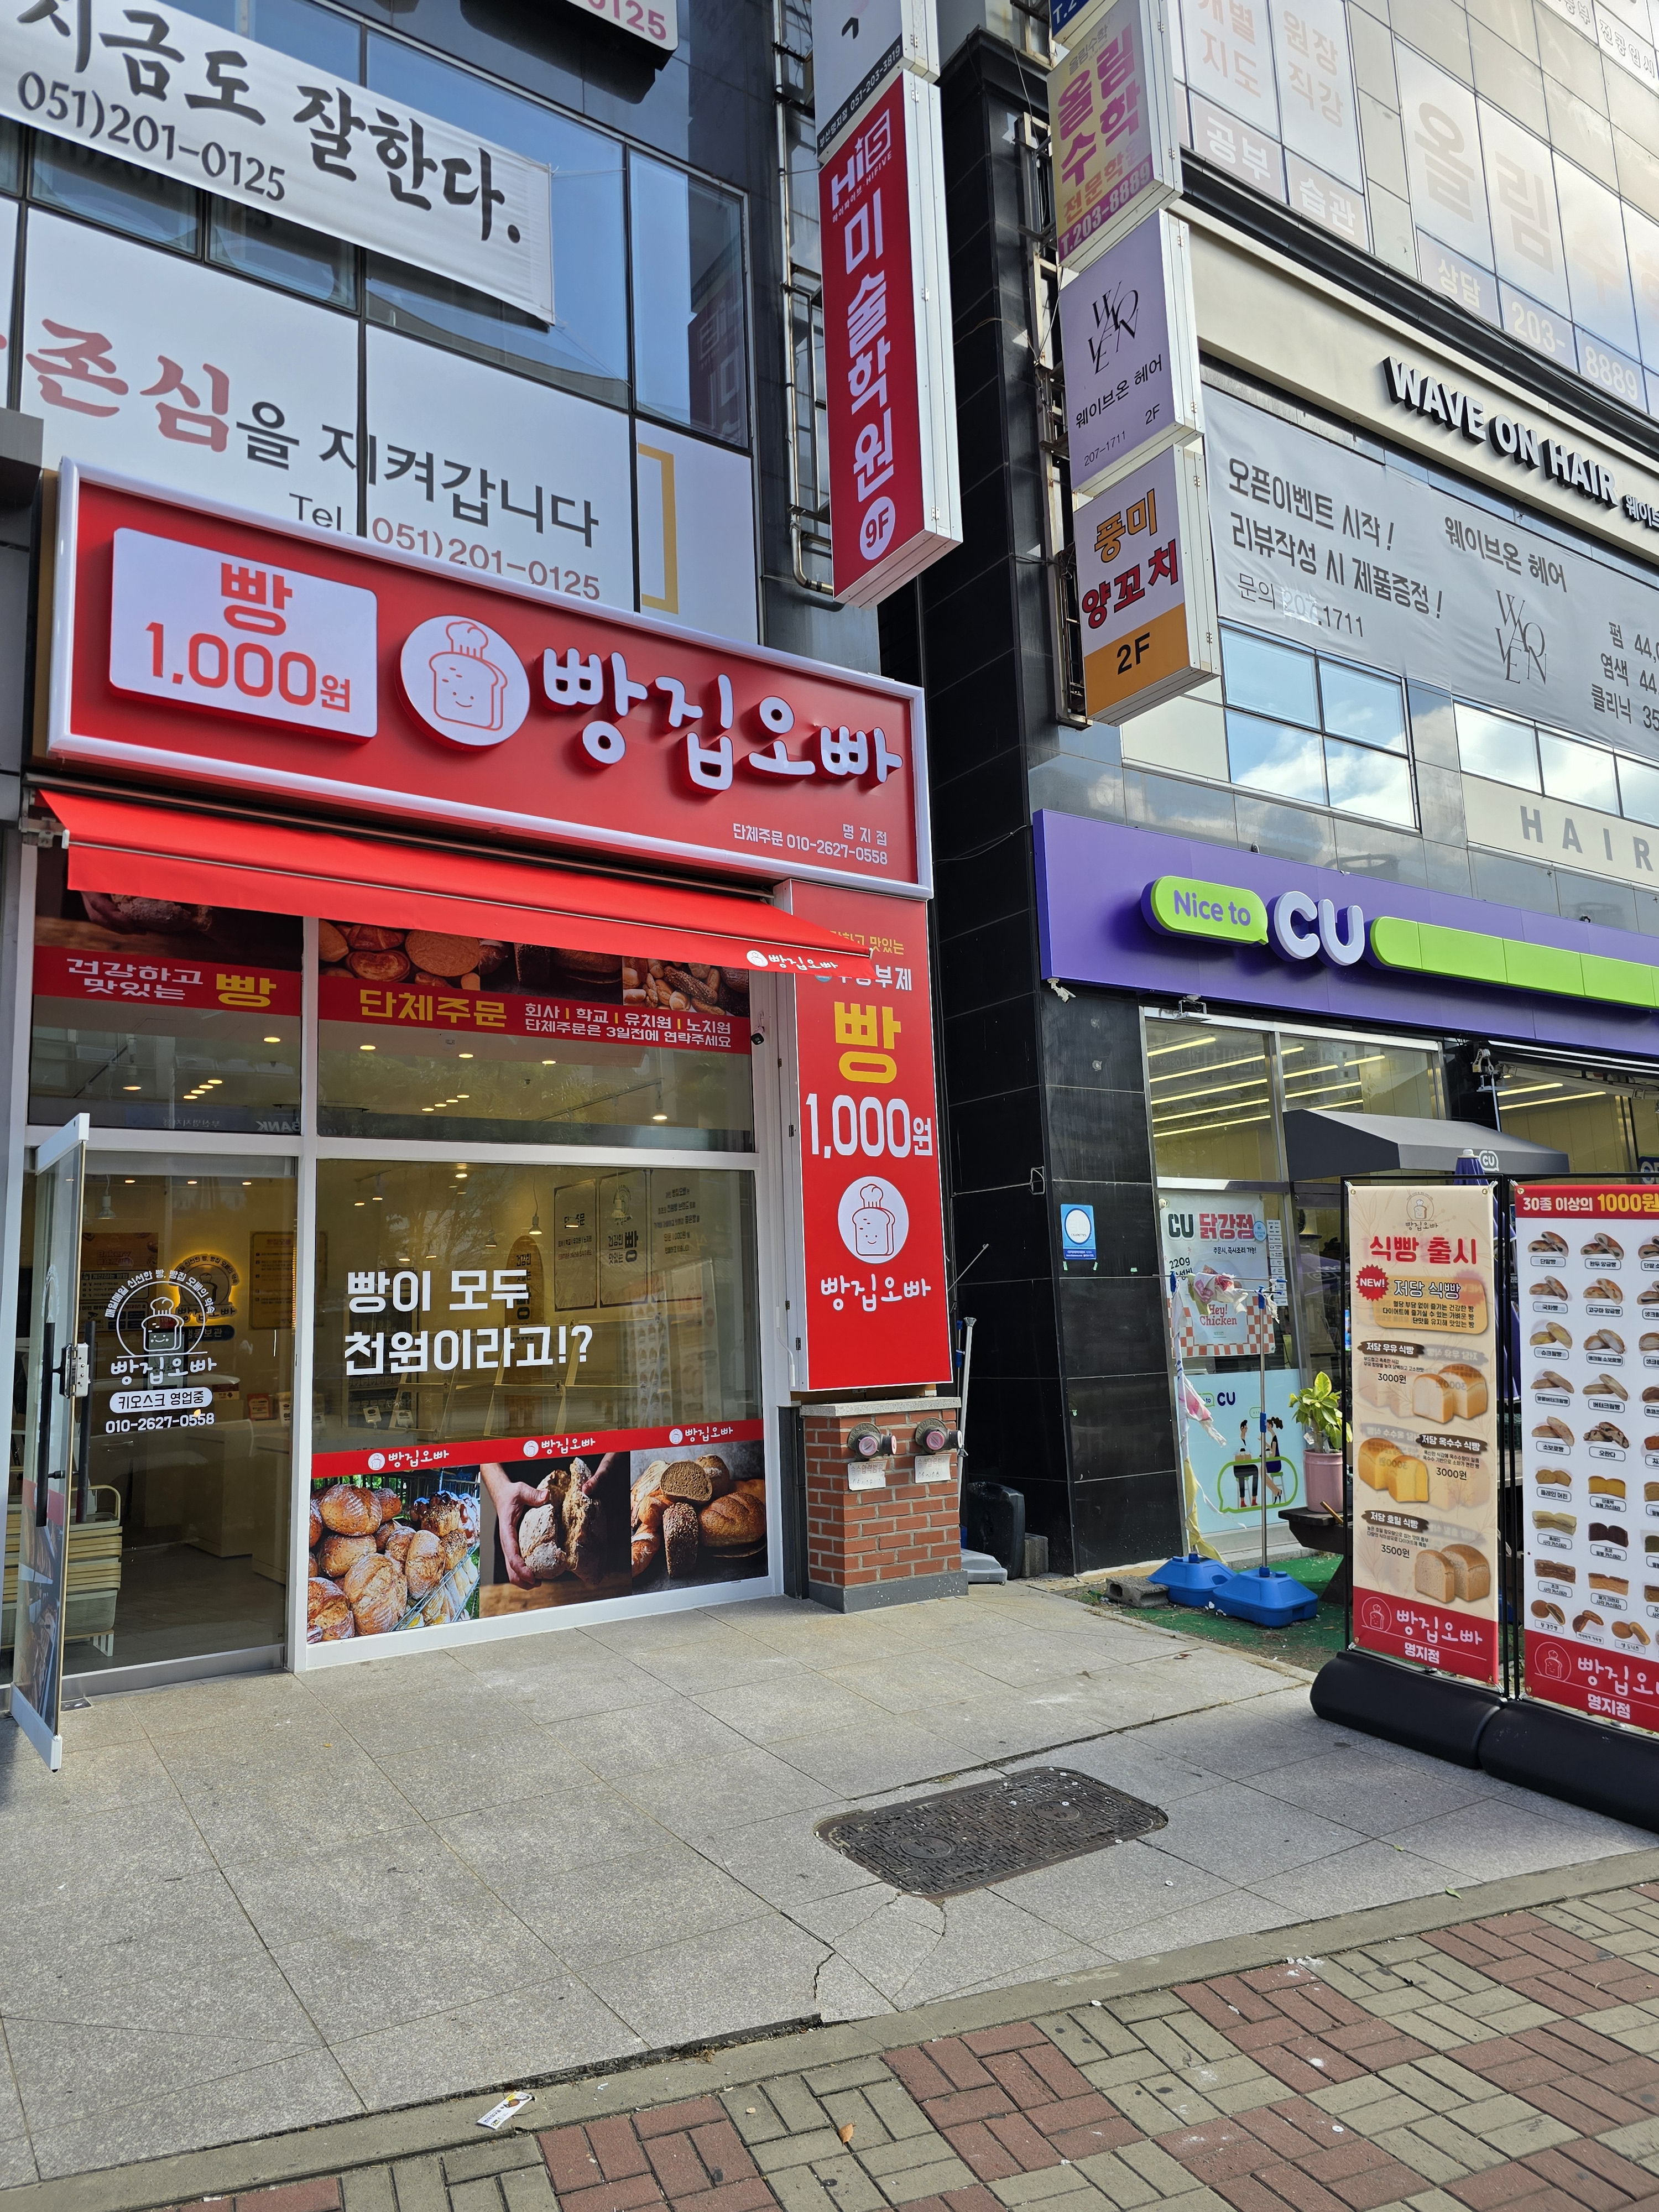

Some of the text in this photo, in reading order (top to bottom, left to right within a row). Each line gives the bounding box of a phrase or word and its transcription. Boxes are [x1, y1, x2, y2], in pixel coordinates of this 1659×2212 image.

[819, 44, 901, 149] 부산명지점 051-203-3819
[17, 0, 521, 244] 지금도 잘한다.
[17, 71, 286, 201] 051)201-0125
[1207, 116, 1271, 181] 공부
[1437, 258, 1481, 309] 상담
[844, 187, 894, 503] 미술학원
[1075, 353, 1162, 429] 웨이브온 헤어
[1145, 403, 1160, 425] 2F
[1083, 430, 1126, 467] 207-1711
[1384, 356, 1619, 508] WAVE ON HAIR
[319, 424, 599, 549] 지켜갑니다
[865, 505, 889, 549] 9F
[1093, 487, 1158, 564] 풍미
[1228, 457, 1334, 531] 오픈이벤트
[1444, 516, 1522, 576] 웨이브온
[1528, 553, 1567, 593] 헤어
[372, 517, 601, 601] 051)201-0125
[1230, 511, 1317, 575] 리뷰작성
[1326, 549, 1345, 586] 시
[221, 562, 293, 637] 빵
[1081, 538, 1179, 629] 양꼬치
[1237, 572, 1276, 610] 문의
[1608, 621, 1625, 650] 펌
[145, 621, 351, 713] 1.000원
[1117, 632, 1151, 676] 2F
[1600, 653, 1629, 687] 염색
[539, 647, 903, 792] 빵집오빠
[1590, 683, 1632, 725] 클리닉
[733, 823, 888, 865] 단체주문 010-2627-0558
[1520, 805, 1654, 872] HAIR
[1173, 889, 1251, 927] Nice to
[1272, 890, 1366, 967] CU
[768, 954, 838, 971] 빵집오빠
[869, 936, 904, 956] 맛있는
[66, 958, 204, 985] 건강하고
[84, 977, 186, 1000] 맛있는
[216, 973, 276, 1008] 빵
[359, 989, 507, 1028] 단체주문
[525, 1003, 731, 1035] 회사 학교 유치원 노치원
[525, 1018, 731, 1048] 단체주문은 3일전에 연락주세요
[833, 1001, 901, 1084] 빵
[805, 1093, 933, 1159] 1,000원
[1482, 1155, 1495, 1166] CU
[1522, 1193, 1659, 1213] 30종 이상의 1000원
[608, 1233, 624, 1247] 건강한
[1167, 1213, 1194, 1239] CU
[1199, 1213, 1255, 1240] 닭강정
[1405, 1221, 1438, 1232] 빵집오빠
[624, 1230, 639, 1263] 빵
[1169, 1256, 1191, 1270] 220g
[1369, 1235, 1477, 1265] 식빵 출시
[105, 1285, 129, 1318] 매일매일
[127, 1270, 153, 1288] 신선한
[169, 1270, 187, 1282] 빵집
[185, 1276, 209, 1298] 오빠의
[347, 1270, 431, 1313] 빵이
[449, 1270, 530, 1311] 모두
[821, 1273, 931, 1312] 빵집오빠
[1359, 1277, 1385, 1288] NEW!
[1394, 1279, 1462, 1300] 저당 식빵
[1199, 1316, 1238, 1326] Chicken
[1208, 1304, 1228, 1317] Hey!
[1383, 1307, 1410, 1316] 다이어트에
[343, 1324, 593, 1376] 천원이라고!?
[1366, 1342, 1415, 1355] 저당 우유 식빵
[110, 1357, 217, 1386] 빵집오빠
[1377, 1373, 1407, 1384] 3000원
[118, 1390, 205, 1410] 키오스크 영업중
[1217, 1391, 1236, 1406] CU
[105, 1412, 215, 1434] 010-2627-0558
[684, 1425, 734, 1444] 빵집오빠
[388, 1449, 450, 1469] 빵집오빠
[541, 1437, 597, 1455] 빵집오빠
[1422, 1434, 1481, 1452] 저당 옥수수 식빵
[1436, 1467, 1467, 1481] 3000원
[1370, 1511, 1419, 1530] 저당 호밀 식빵
[1380, 1544, 1410, 1559] 3500원
[1396, 1609, 1483, 1645] 빵집오빠
[1404, 1642, 1440, 1665] 명지점
[1577, 1657, 1659, 1696] 빵집오
[1587, 1693, 1630, 1720] 명지점
